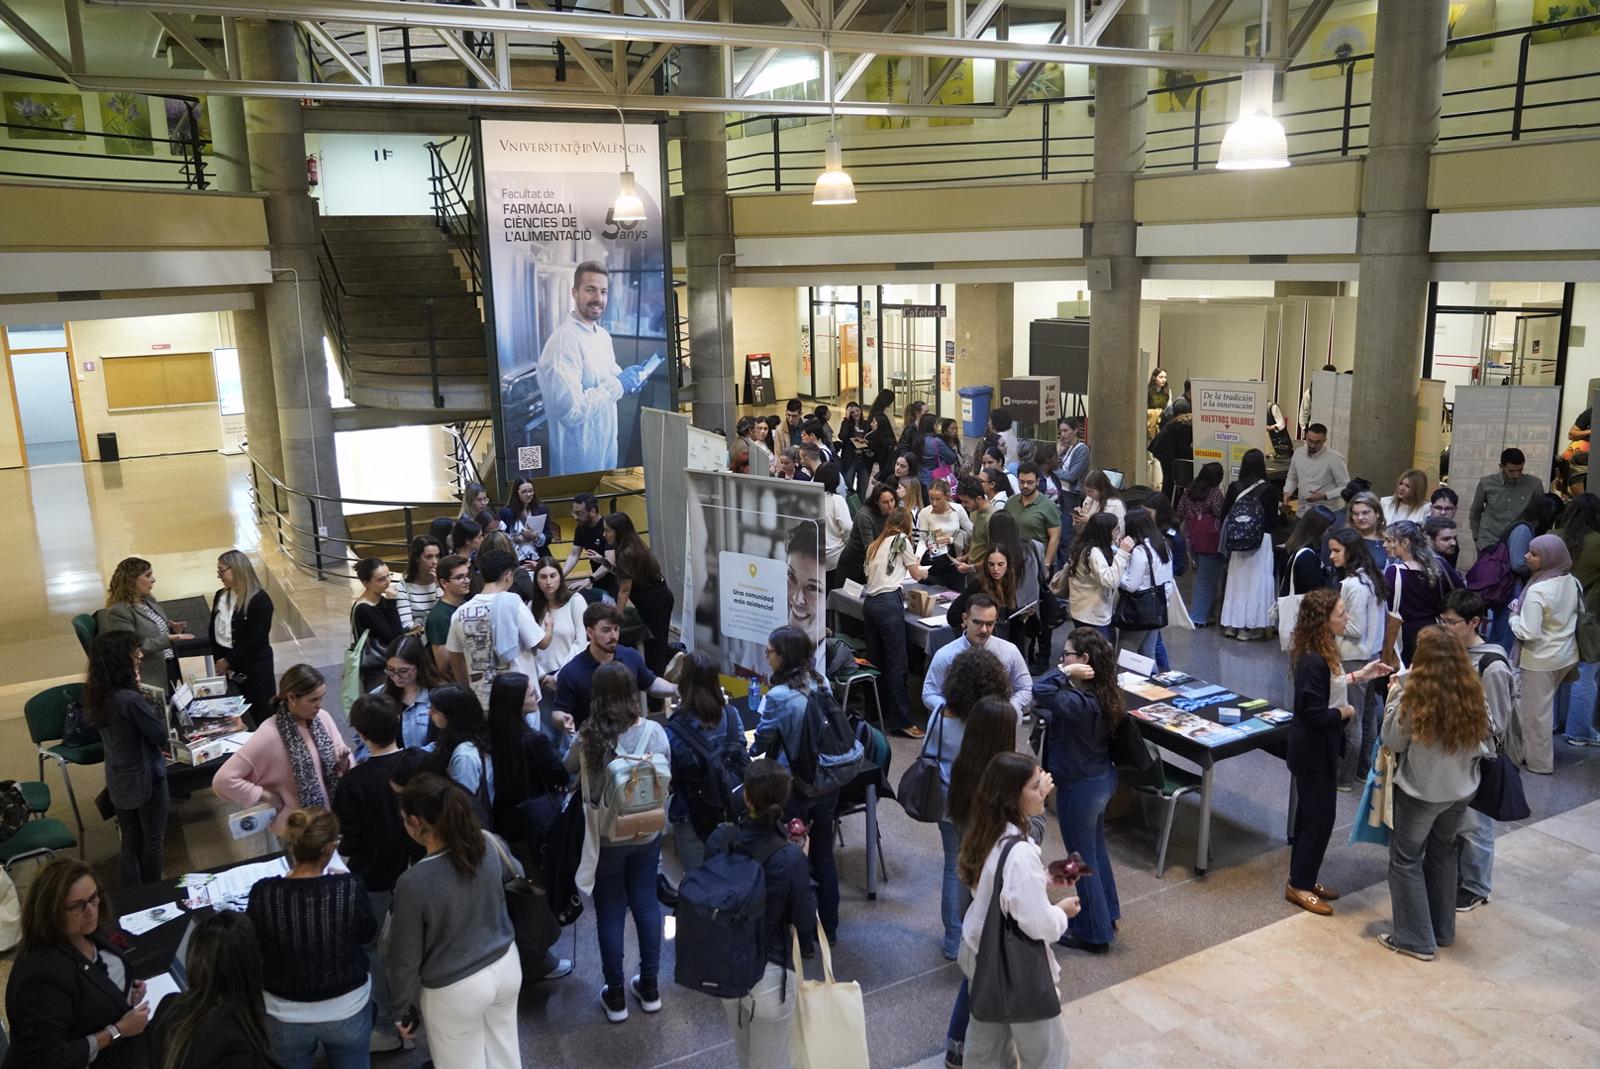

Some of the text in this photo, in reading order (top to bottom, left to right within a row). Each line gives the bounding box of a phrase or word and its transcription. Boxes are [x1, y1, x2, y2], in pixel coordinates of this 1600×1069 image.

[502, 188, 555, 199] Facultat de
[503, 201, 572, 214] FARMÀCIA I
[504, 215, 578, 229] CIÈNCIES DE
[505, 227, 592, 243] L'ALIMENTACIÓ
[619, 230, 648, 242] anys
[1203, 391, 1253, 403] De la tradición
[1216, 401, 1253, 410] innovación
[1200, 414, 1255, 426] NUESTROS VALORES
[732, 588, 774, 603] Una comunidad
